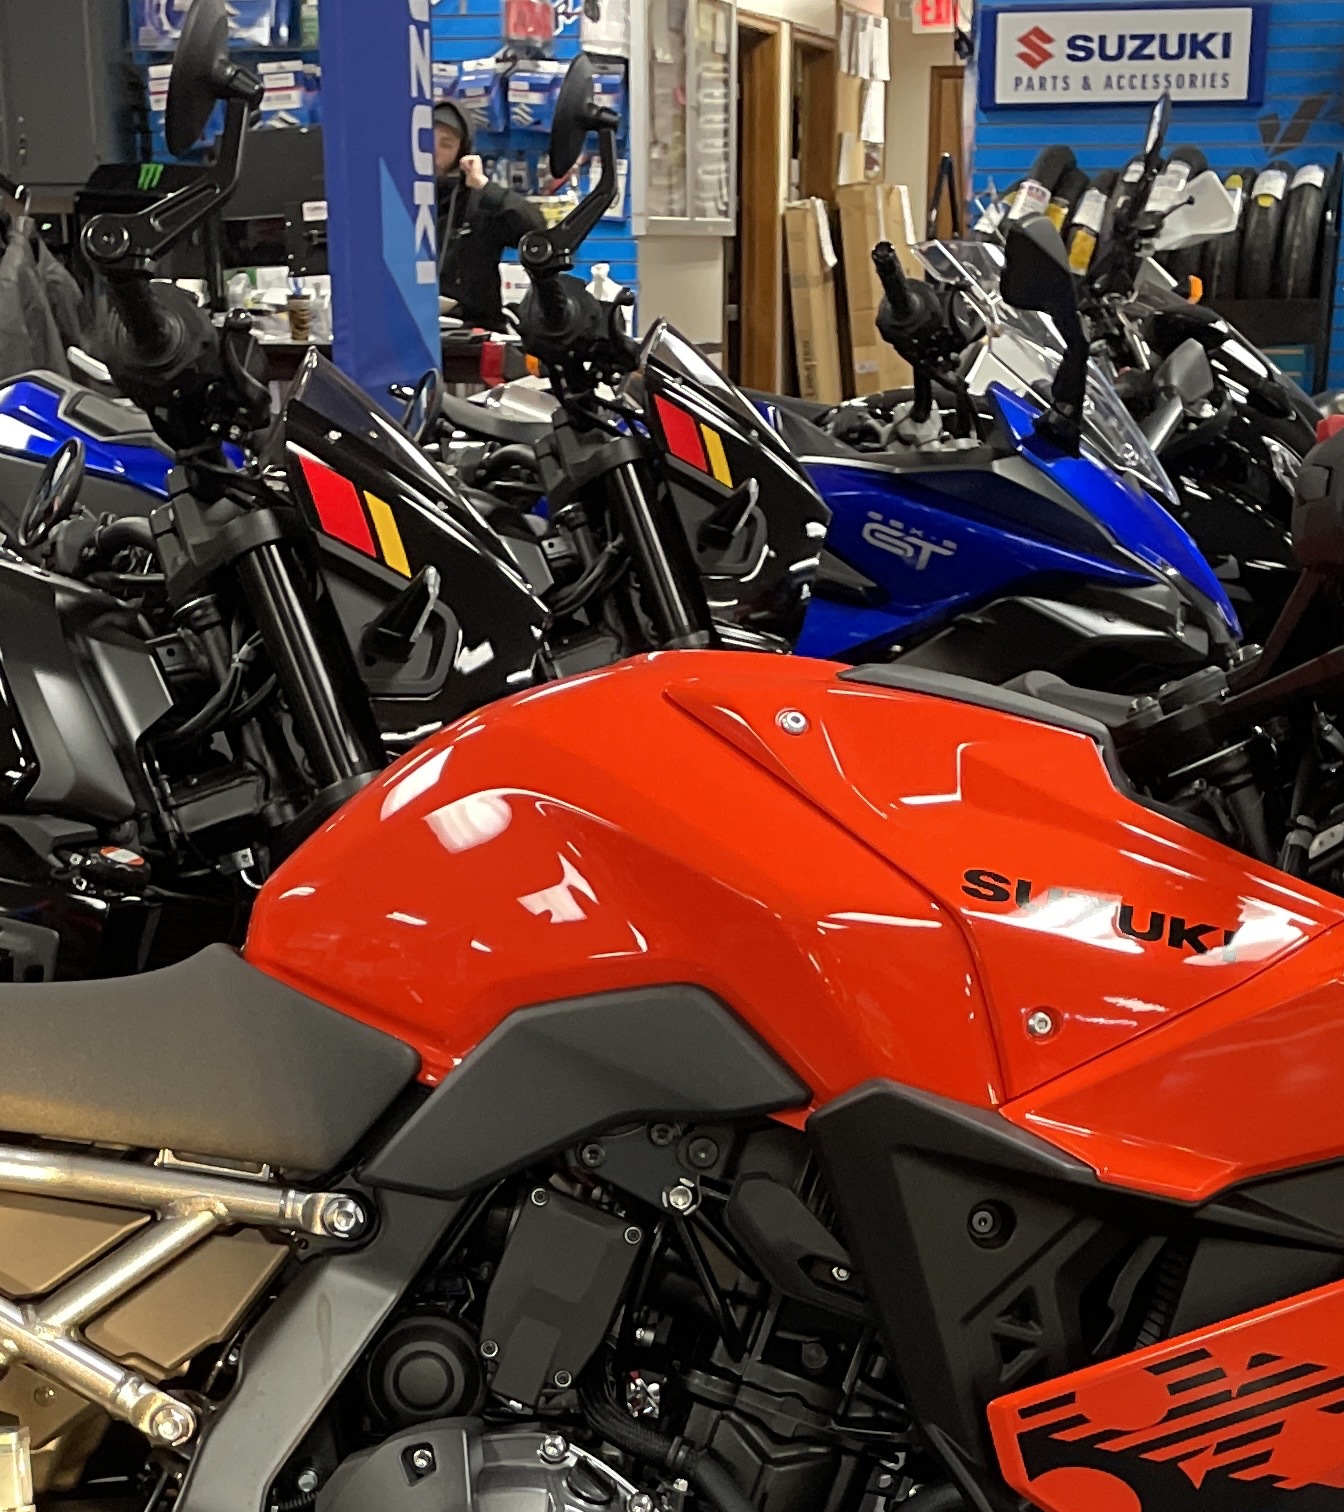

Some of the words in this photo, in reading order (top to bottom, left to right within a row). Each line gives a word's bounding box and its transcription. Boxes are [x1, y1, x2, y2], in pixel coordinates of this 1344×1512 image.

[1066, 32, 1232, 62] SUZUKI
[1014, 75, 1070, 92] PARTS
[1082, 76, 1092, 91] &
[1105, 72, 1230, 91] ACCESSORIES
